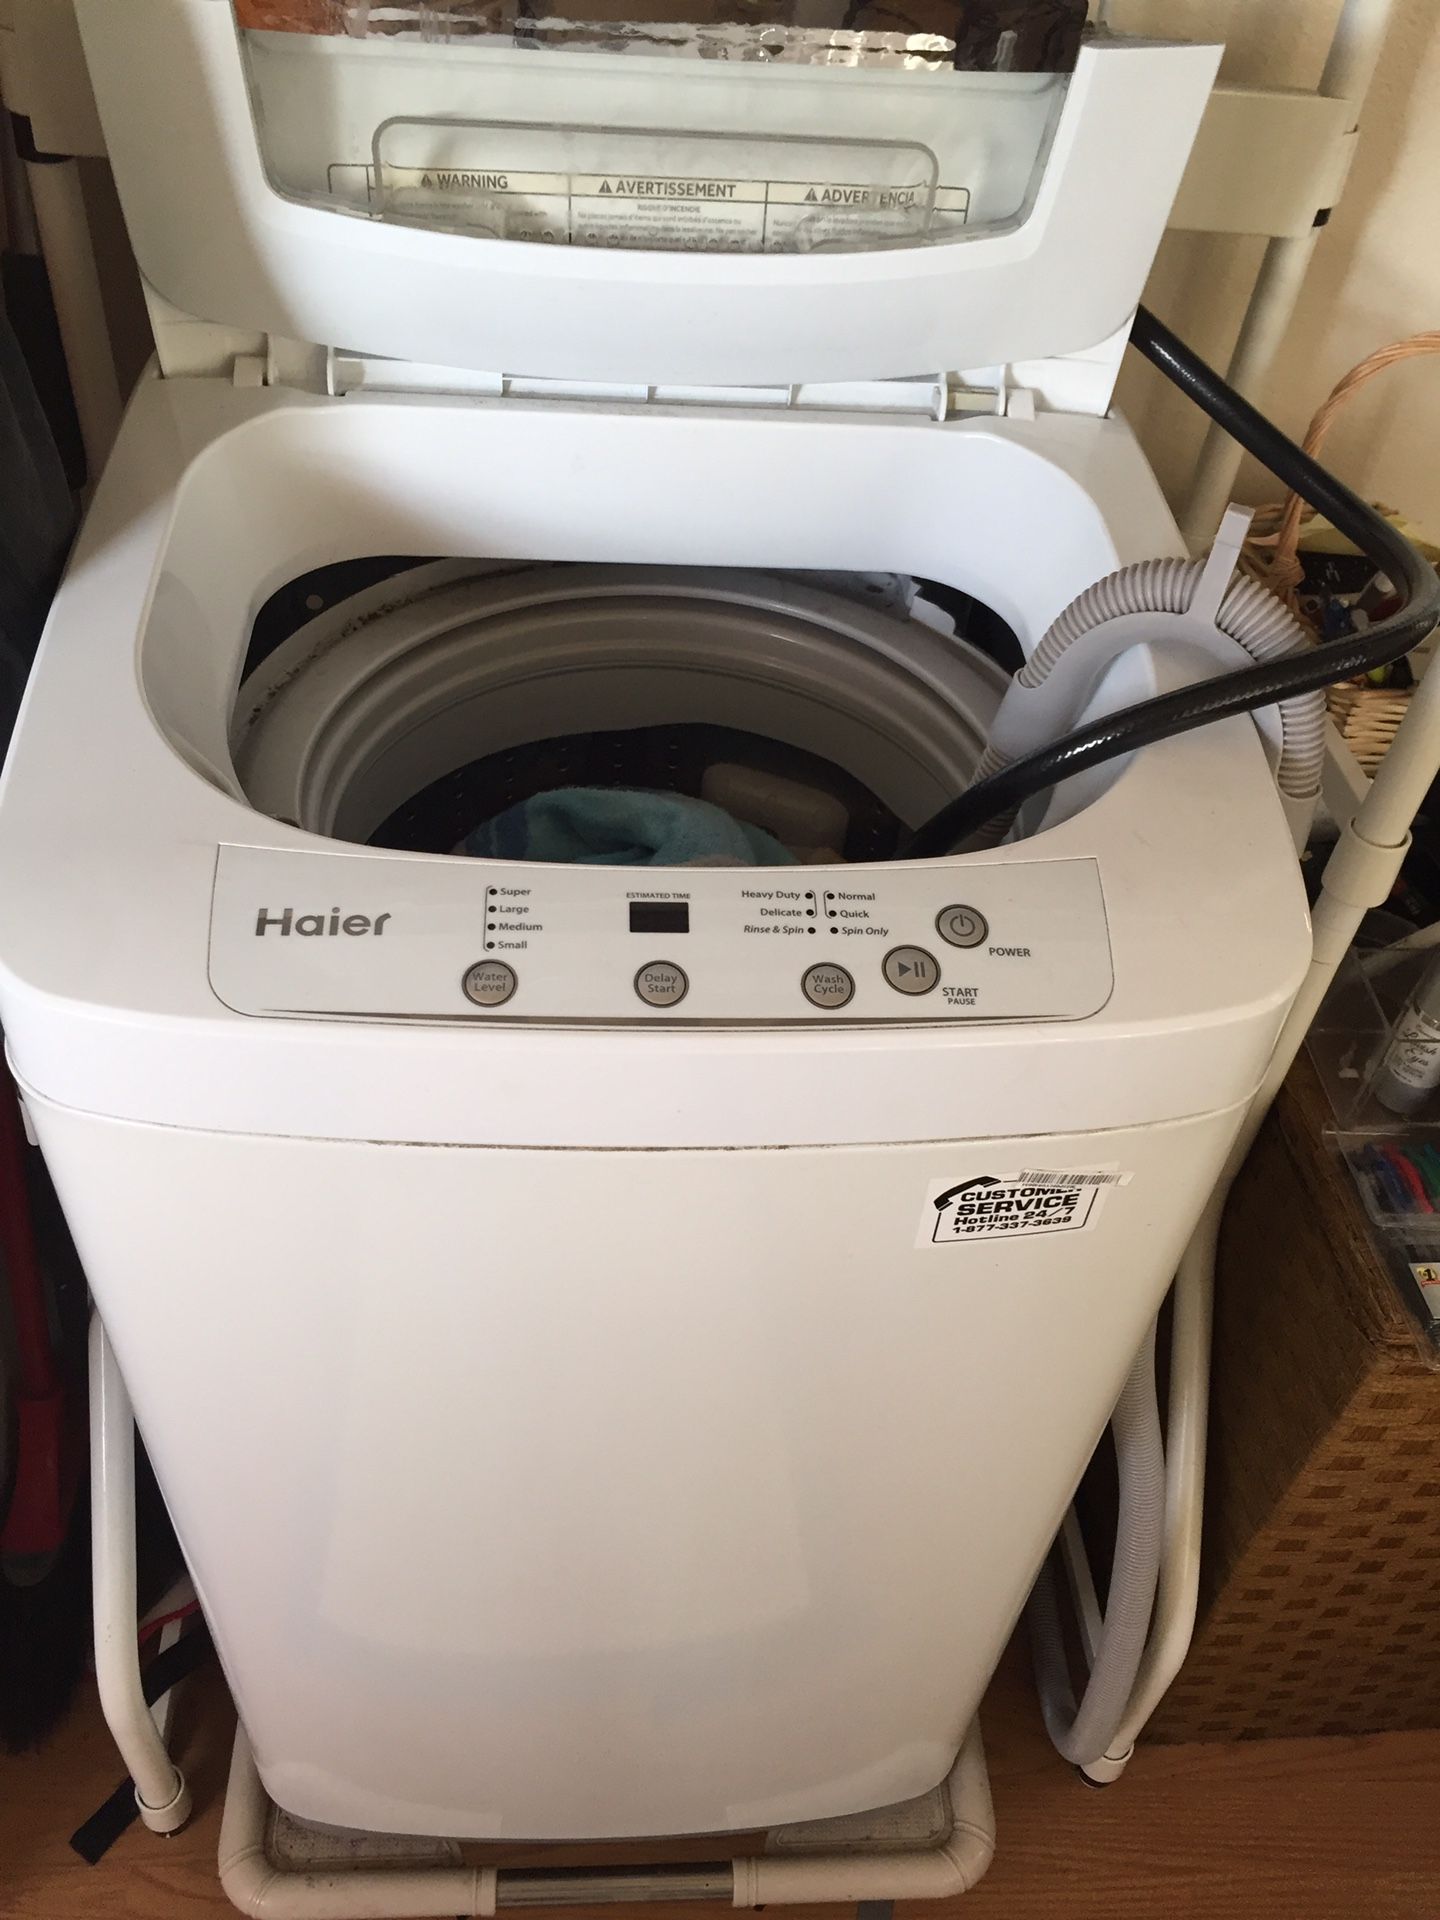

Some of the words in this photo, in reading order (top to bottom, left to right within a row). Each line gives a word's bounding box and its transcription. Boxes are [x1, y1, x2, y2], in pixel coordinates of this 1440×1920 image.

[437, 173, 508, 189] WARNING
[615, 181, 736, 198] AVERTISSEMENT
[822, 189, 915, 208] ADVERENCIA
[500, 887, 531, 898] Super
[741, 890, 773, 900] Heavy
[776, 890, 801, 901] Duty
[838, 892, 876, 901] Normal
[499, 905, 529, 916] Large
[760, 907, 802, 917] Delicate
[840, 908, 869, 919] Quick
[255, 907, 392, 936] Haier
[499, 922, 543, 931] Medium
[744, 925, 771, 934] Rinse
[773, 925, 780, 934] &
[782, 925, 804, 936] Spin
[842, 926, 862, 936] Spin
[865, 926, 889, 937] Only
[498, 940, 527, 950] Small
[989, 947, 1031, 958] POWER
[473, 971, 508, 983] Water
[644, 973, 677, 985] Delay
[813, 974, 844, 985] Wash
[475, 982, 506, 993] Level
[647, 983, 675, 994] Start
[814, 984, 844, 996] Cycle
[942, 987, 979, 998] START
[948, 997, 975, 1006] PAUSE
[957, 1193, 1080, 1216] SERVICE
[954, 1214, 1019, 1226] Hotline
[1023, 1206, 1075, 1220] 24/7
[952, 1216, 1072, 1234] 1-877-337-3639
